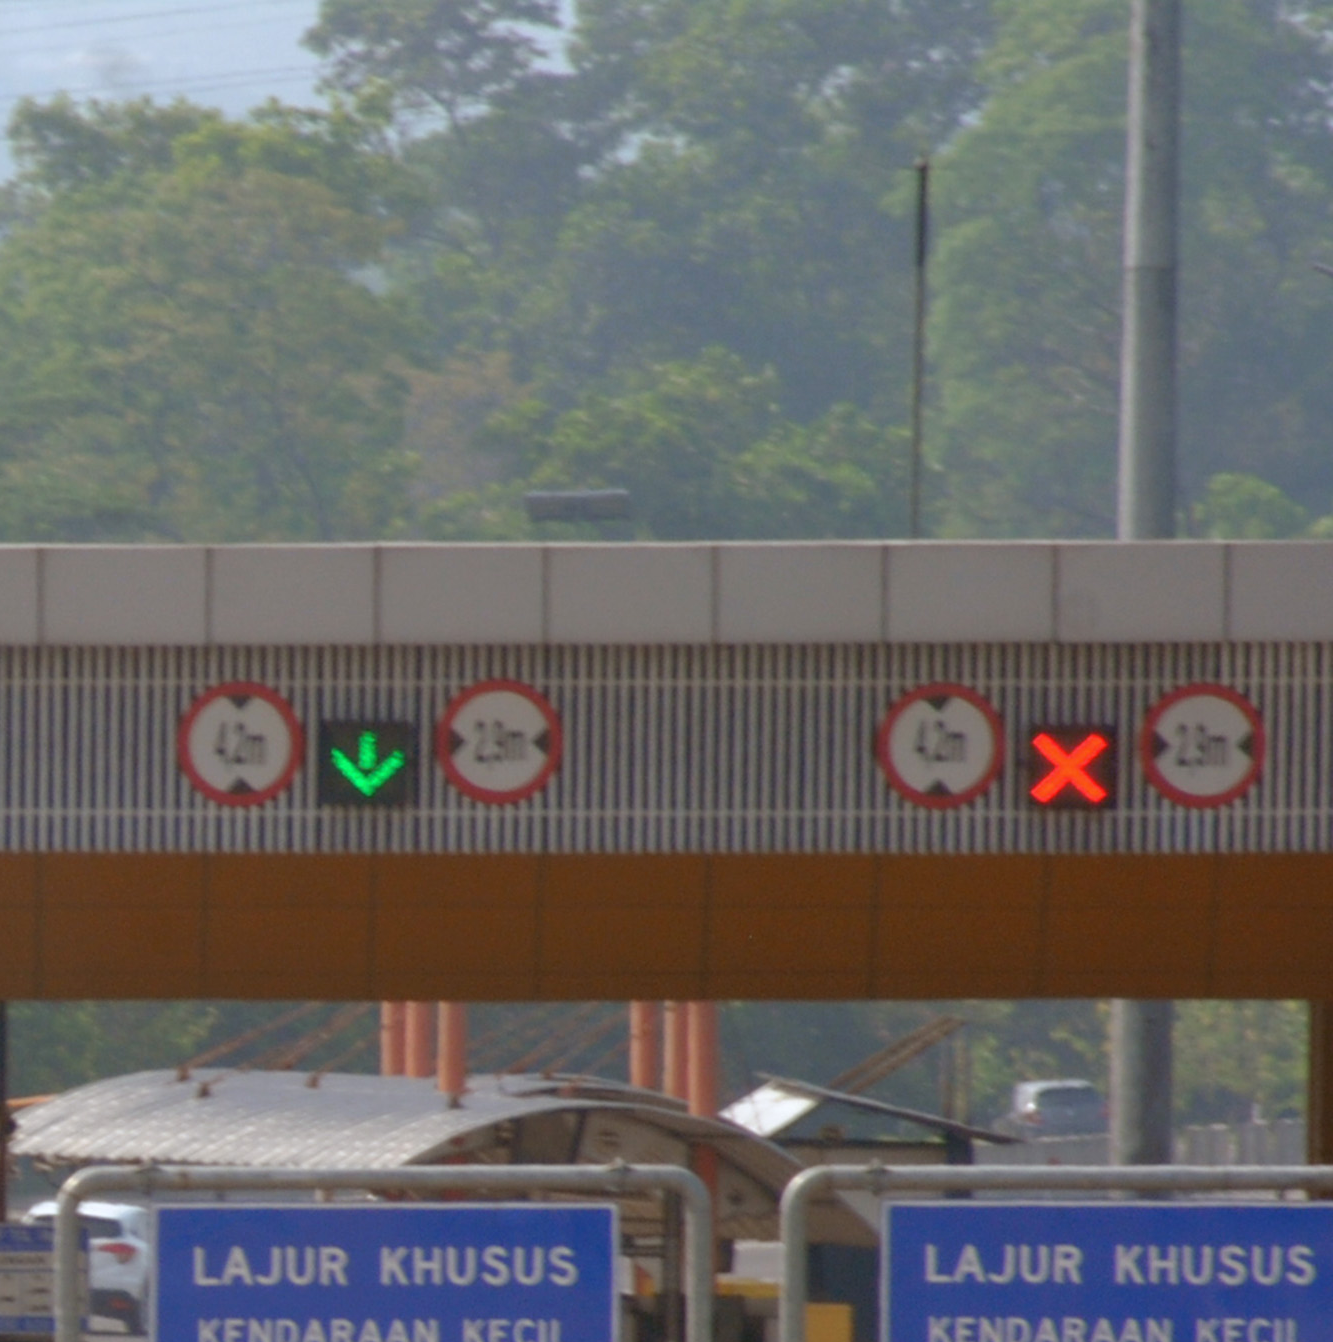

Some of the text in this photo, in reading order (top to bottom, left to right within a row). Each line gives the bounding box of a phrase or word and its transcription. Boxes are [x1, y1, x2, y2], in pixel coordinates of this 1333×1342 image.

[193, 1246, 579, 1288] LAJUR KHUSUS
[923, 1244, 1317, 1287] LAJUR KHUSUS
